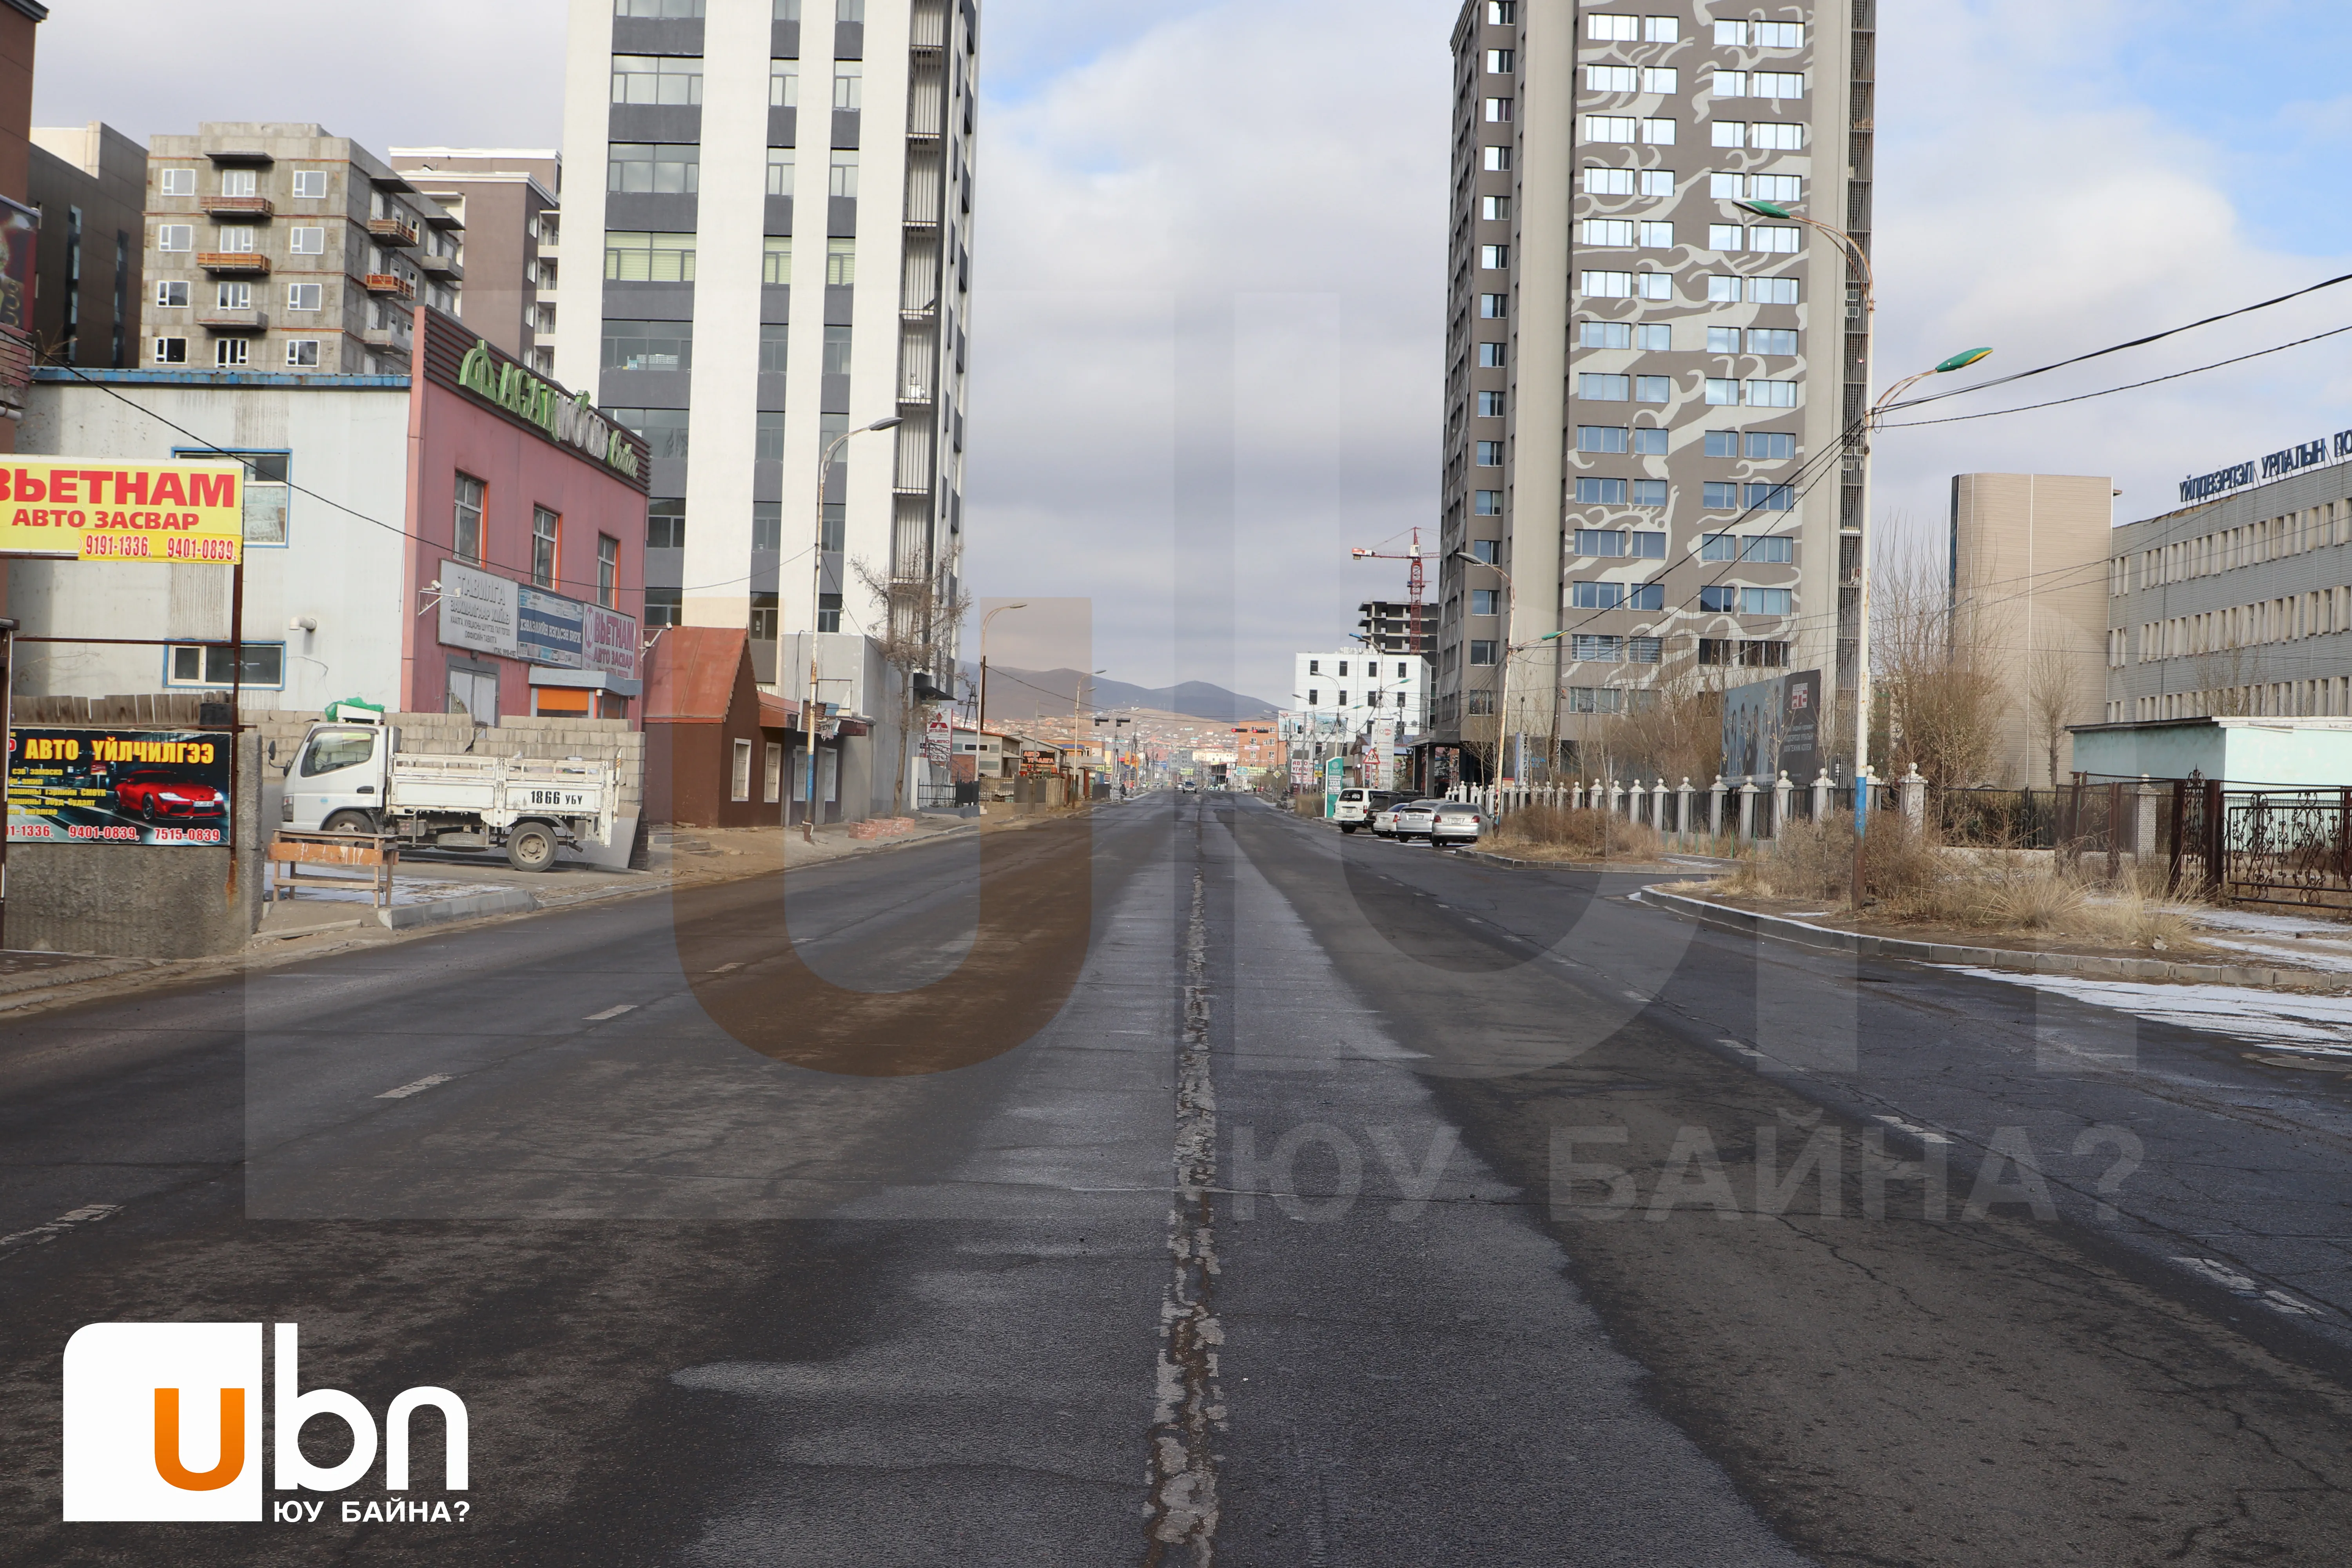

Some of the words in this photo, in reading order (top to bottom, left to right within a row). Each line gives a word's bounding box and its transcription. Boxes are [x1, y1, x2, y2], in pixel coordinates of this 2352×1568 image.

[12, 508, 86, 528] АВТО
[94, 511, 199, 530] ЗАСВАР
[594, 612, 634, 652] ВЬЕТНАМ
[593, 647, 610, 664] АВТО
[611, 650, 633, 669] ЗАСВАР
[24, 738, 80, 761] АВТО
[91, 736, 215, 764] ҮЙЛЧИЛГЭЭ
[531, 791, 560, 804] 1866
[565, 795, 583, 805] УБҮ
[67, 825, 140, 841] 9401-0839,
[154, 827, 221, 842] 7515-0839
